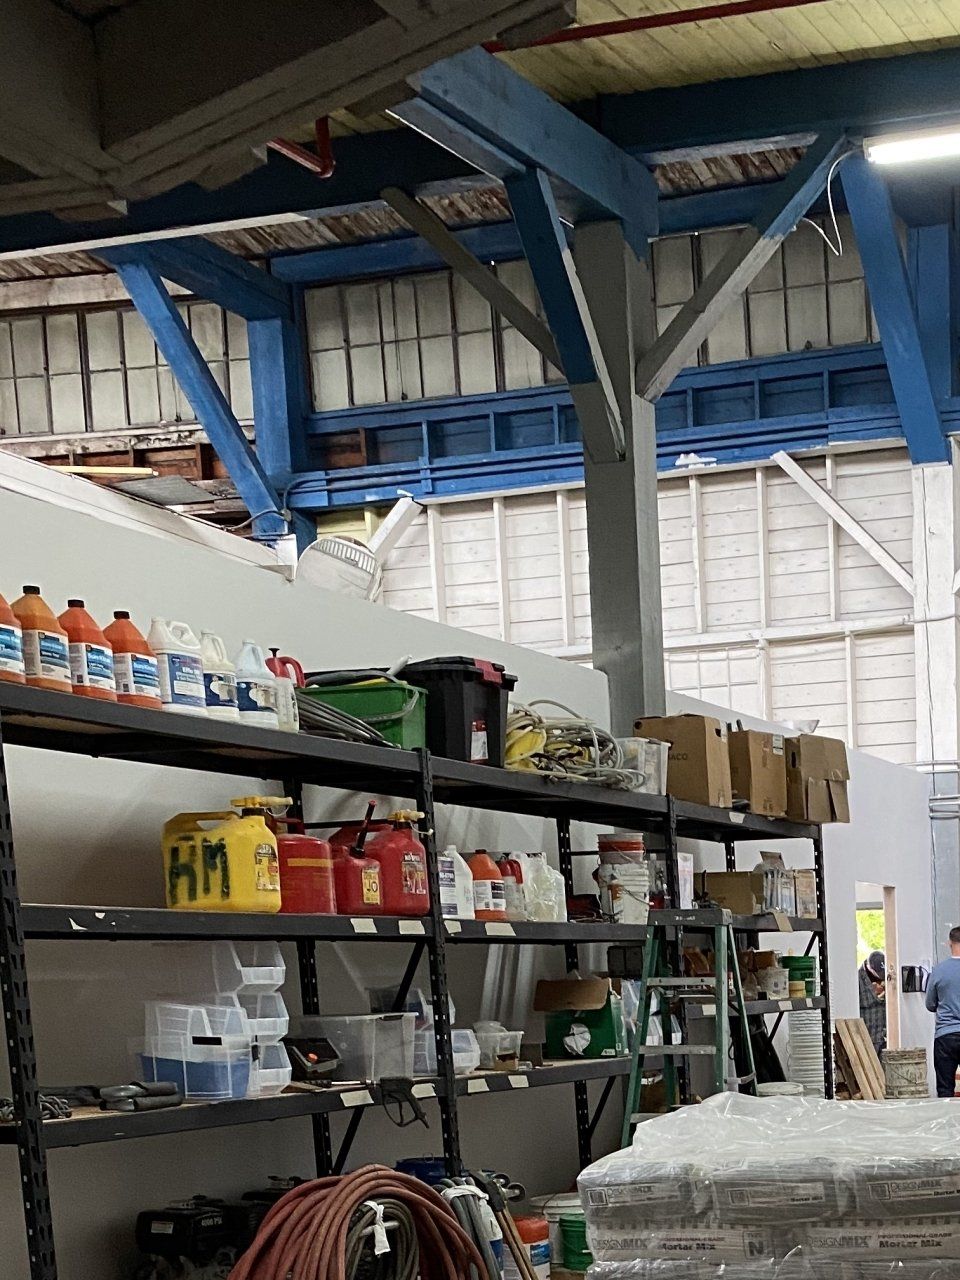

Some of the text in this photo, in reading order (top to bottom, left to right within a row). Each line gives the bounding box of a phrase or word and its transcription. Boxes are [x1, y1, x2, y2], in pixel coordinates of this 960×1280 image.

[749, 1241, 764, 1255] N
[879, 1240, 942, 1248] Mortar Mix
